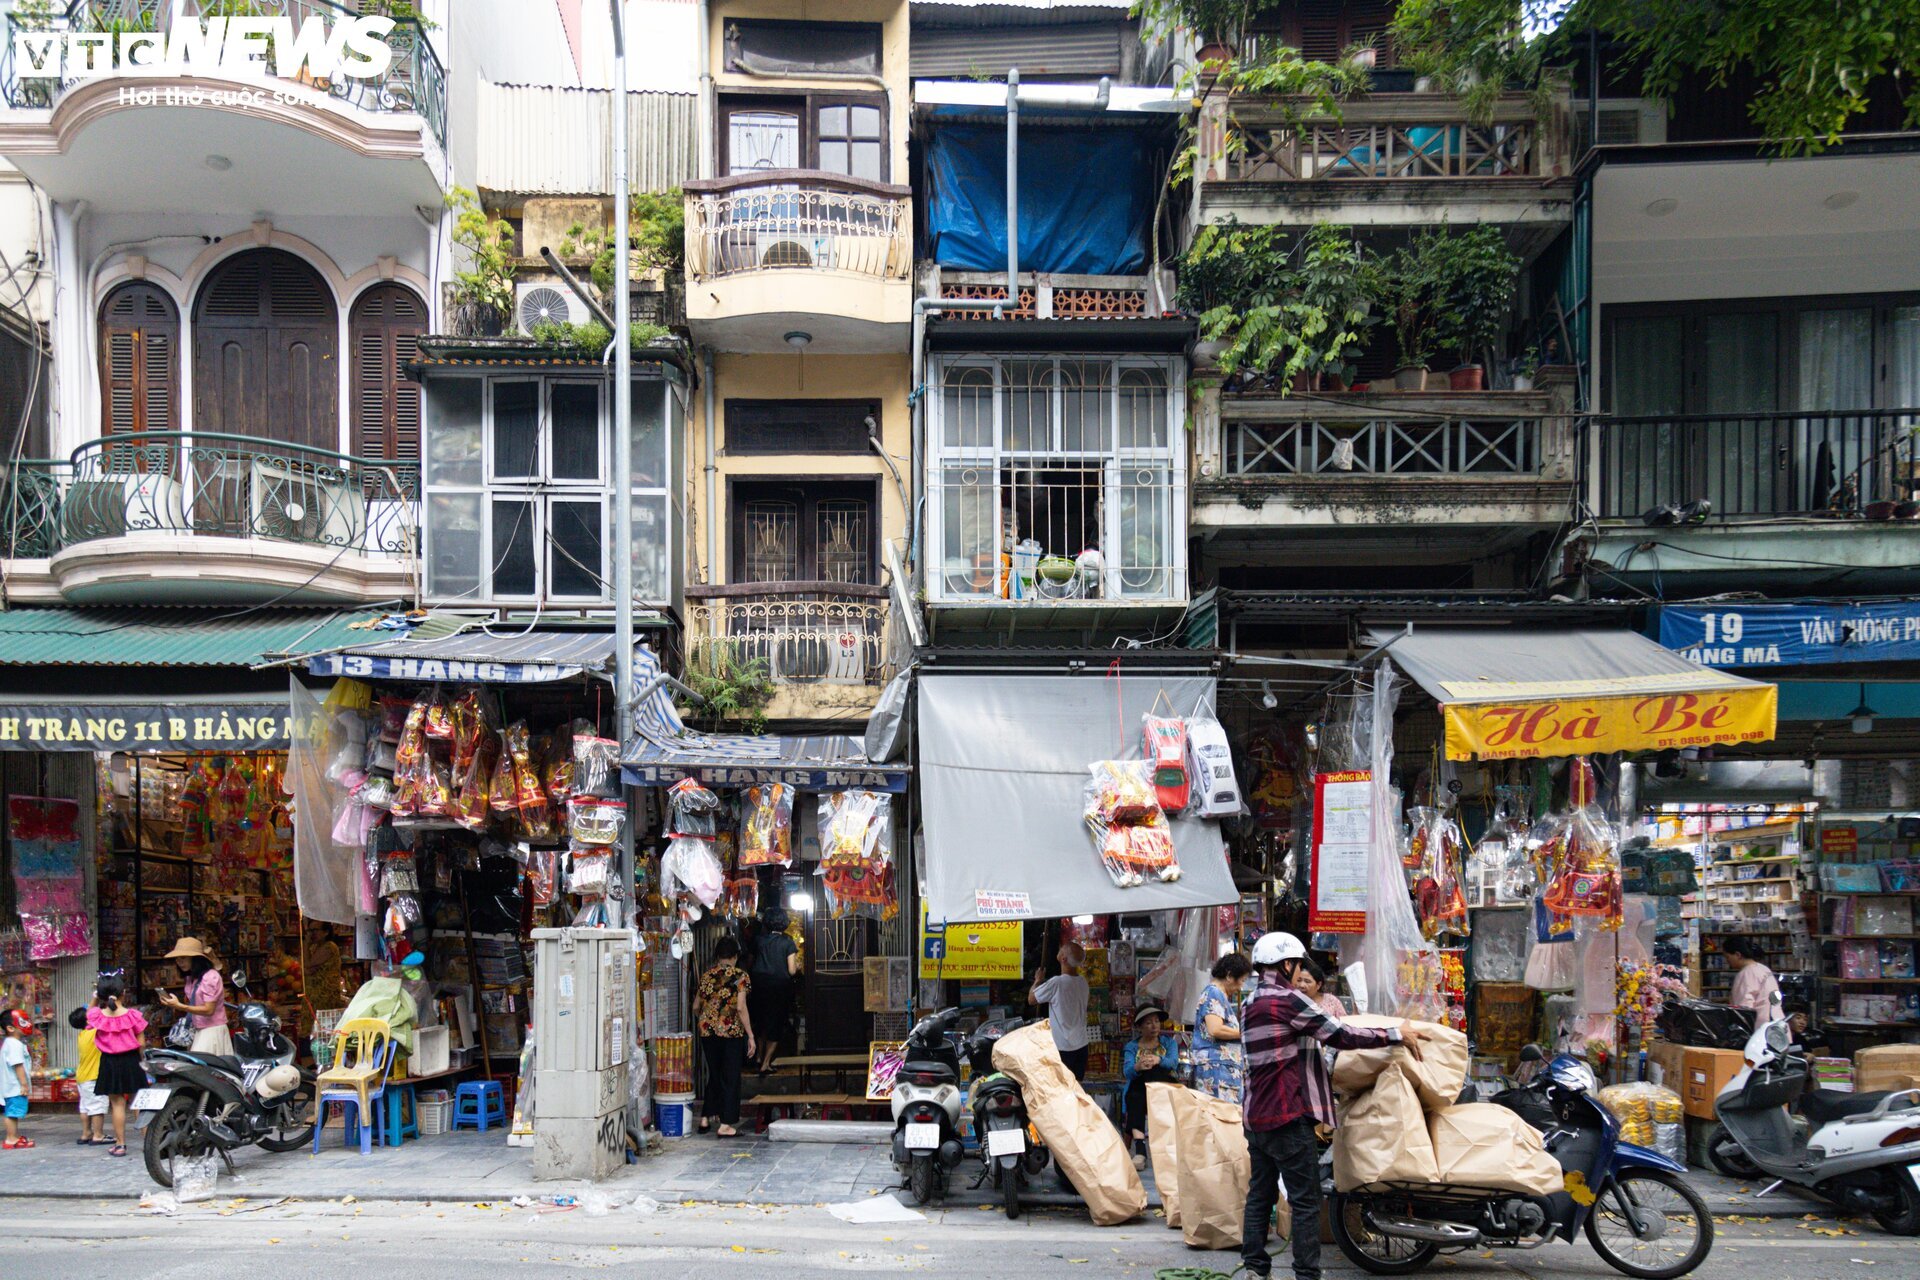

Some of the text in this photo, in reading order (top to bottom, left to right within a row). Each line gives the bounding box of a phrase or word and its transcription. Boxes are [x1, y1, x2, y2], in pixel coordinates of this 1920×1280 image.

[1701, 613, 1743, 643] 19
[1801, 616, 1836, 645] VĂN
[1841, 612, 1900, 643] PHÒNG
[325, 656, 372, 676] 13
[1743, 644, 1781, 663] MÃ
[26, 718, 127, 742] TRANG
[134, 721, 162, 742] 11
[169, 719, 187, 741] B
[194, 711, 276, 741] HÀNG
[1480, 694, 1734, 746] Hà Bé
[1680, 735, 1710, 746] 0856
[1715, 733, 1737, 743] 894
[1742, 730, 1765, 741] 098
[637, 767, 691, 782] 15
